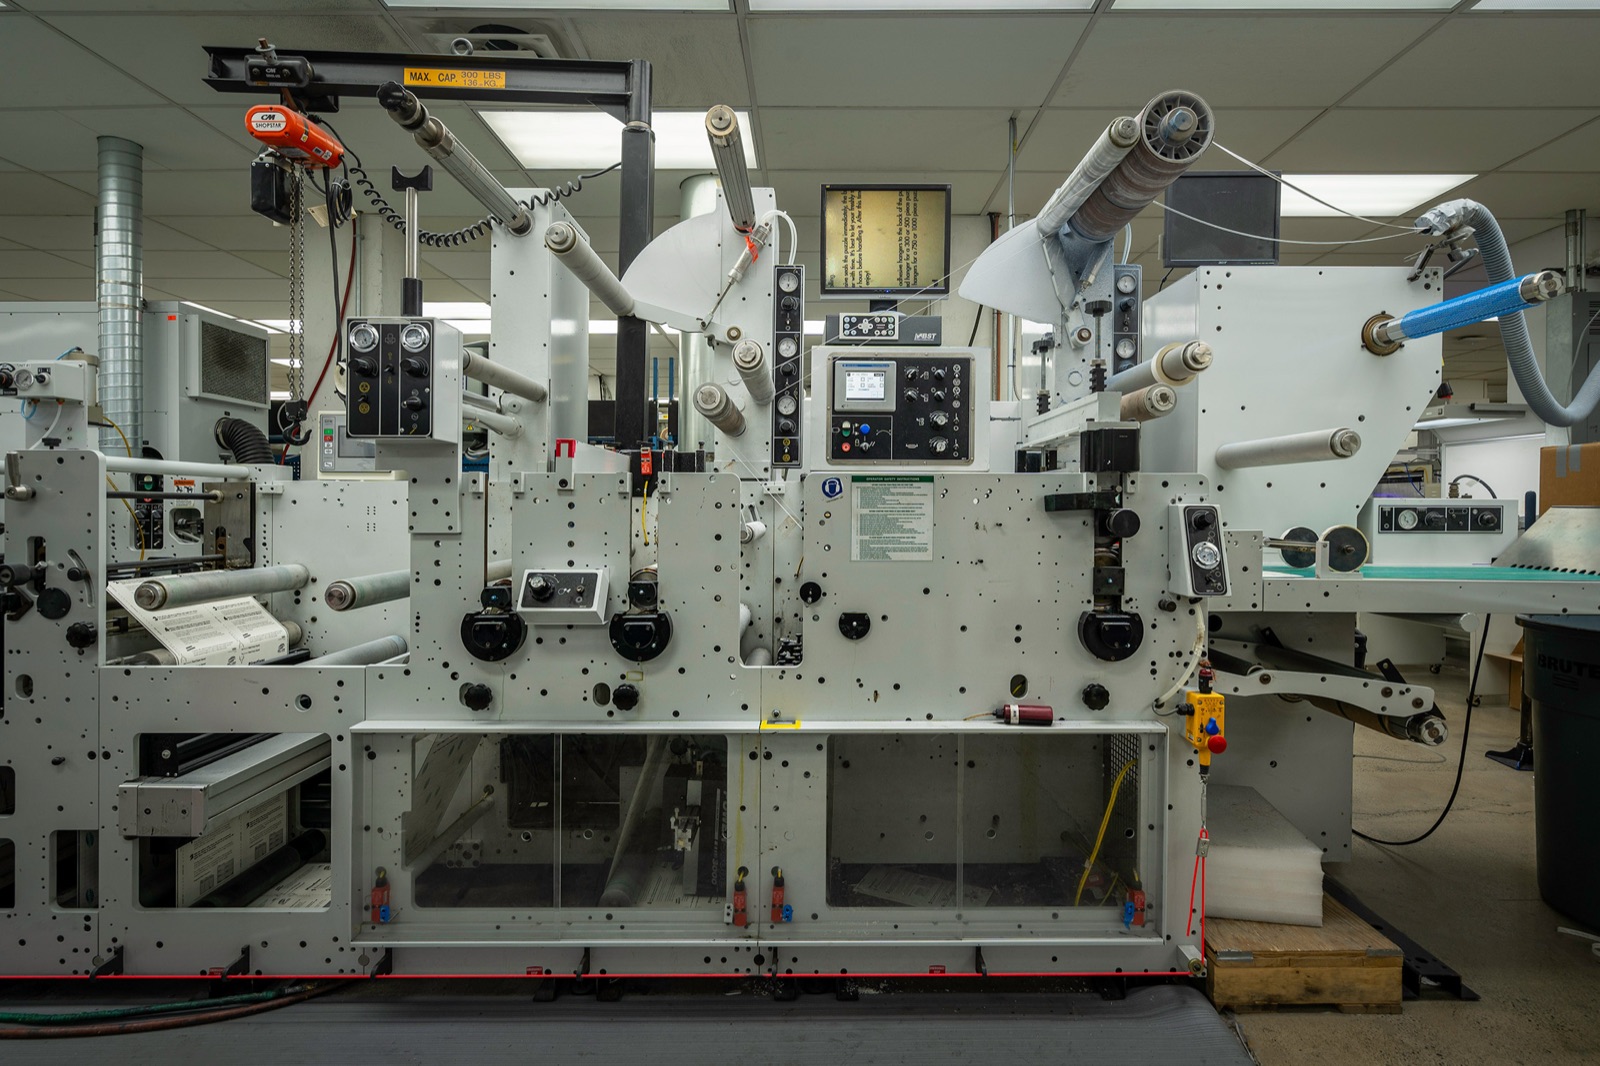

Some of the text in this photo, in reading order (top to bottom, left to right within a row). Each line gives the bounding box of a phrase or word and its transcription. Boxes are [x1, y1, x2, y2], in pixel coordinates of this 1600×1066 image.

[409, 71, 458, 83] MAX. CAP.
[460, 71, 503, 80] 300 LBS.
[463, 79, 478, 87] 136
